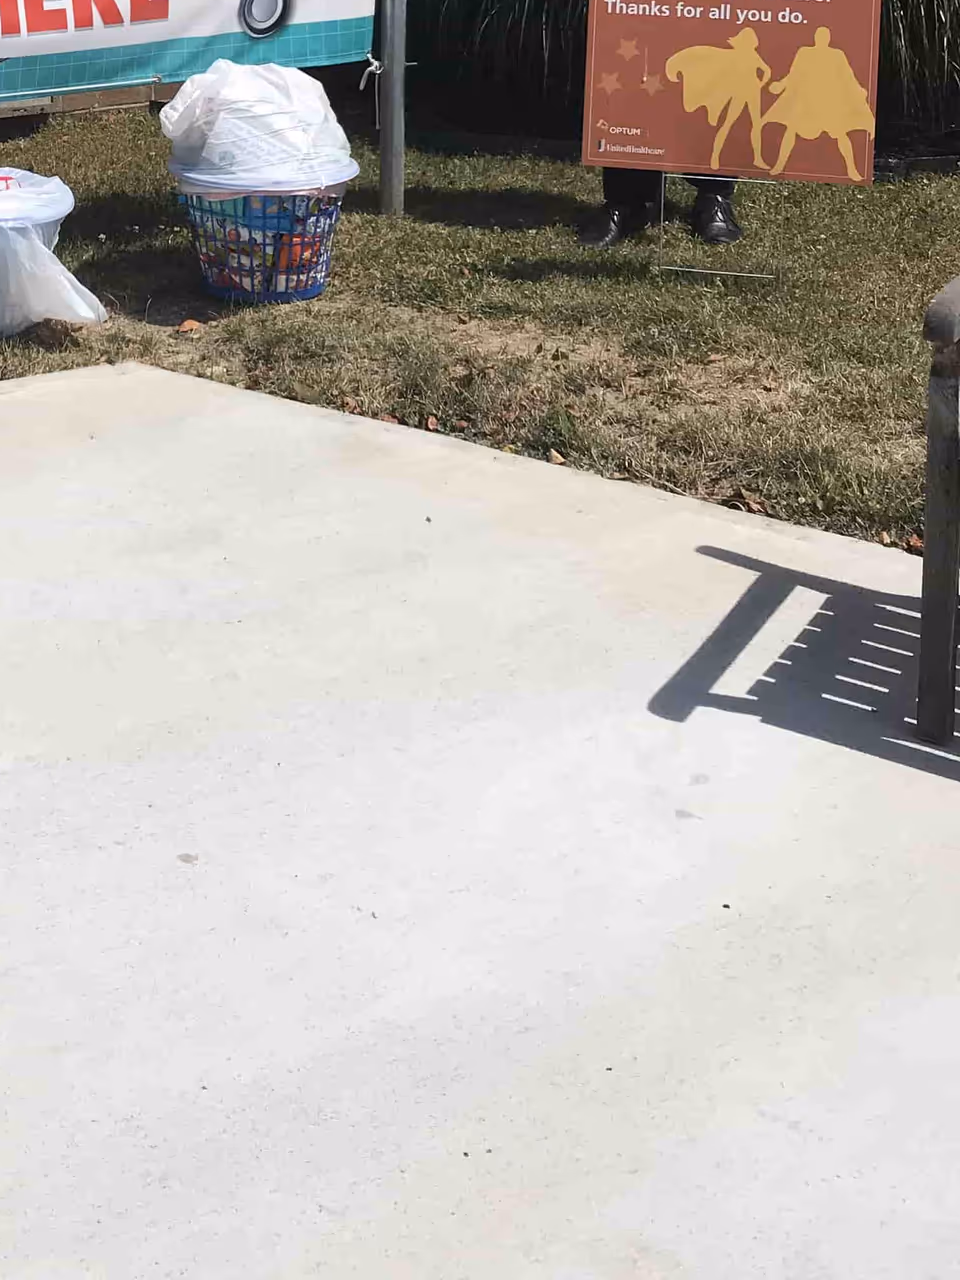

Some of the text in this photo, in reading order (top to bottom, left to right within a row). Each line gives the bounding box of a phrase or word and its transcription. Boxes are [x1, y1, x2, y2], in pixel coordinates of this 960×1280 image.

[604, 0, 808, 24] Thanks for all you do.
[609, 126, 641, 136] OPTUM
